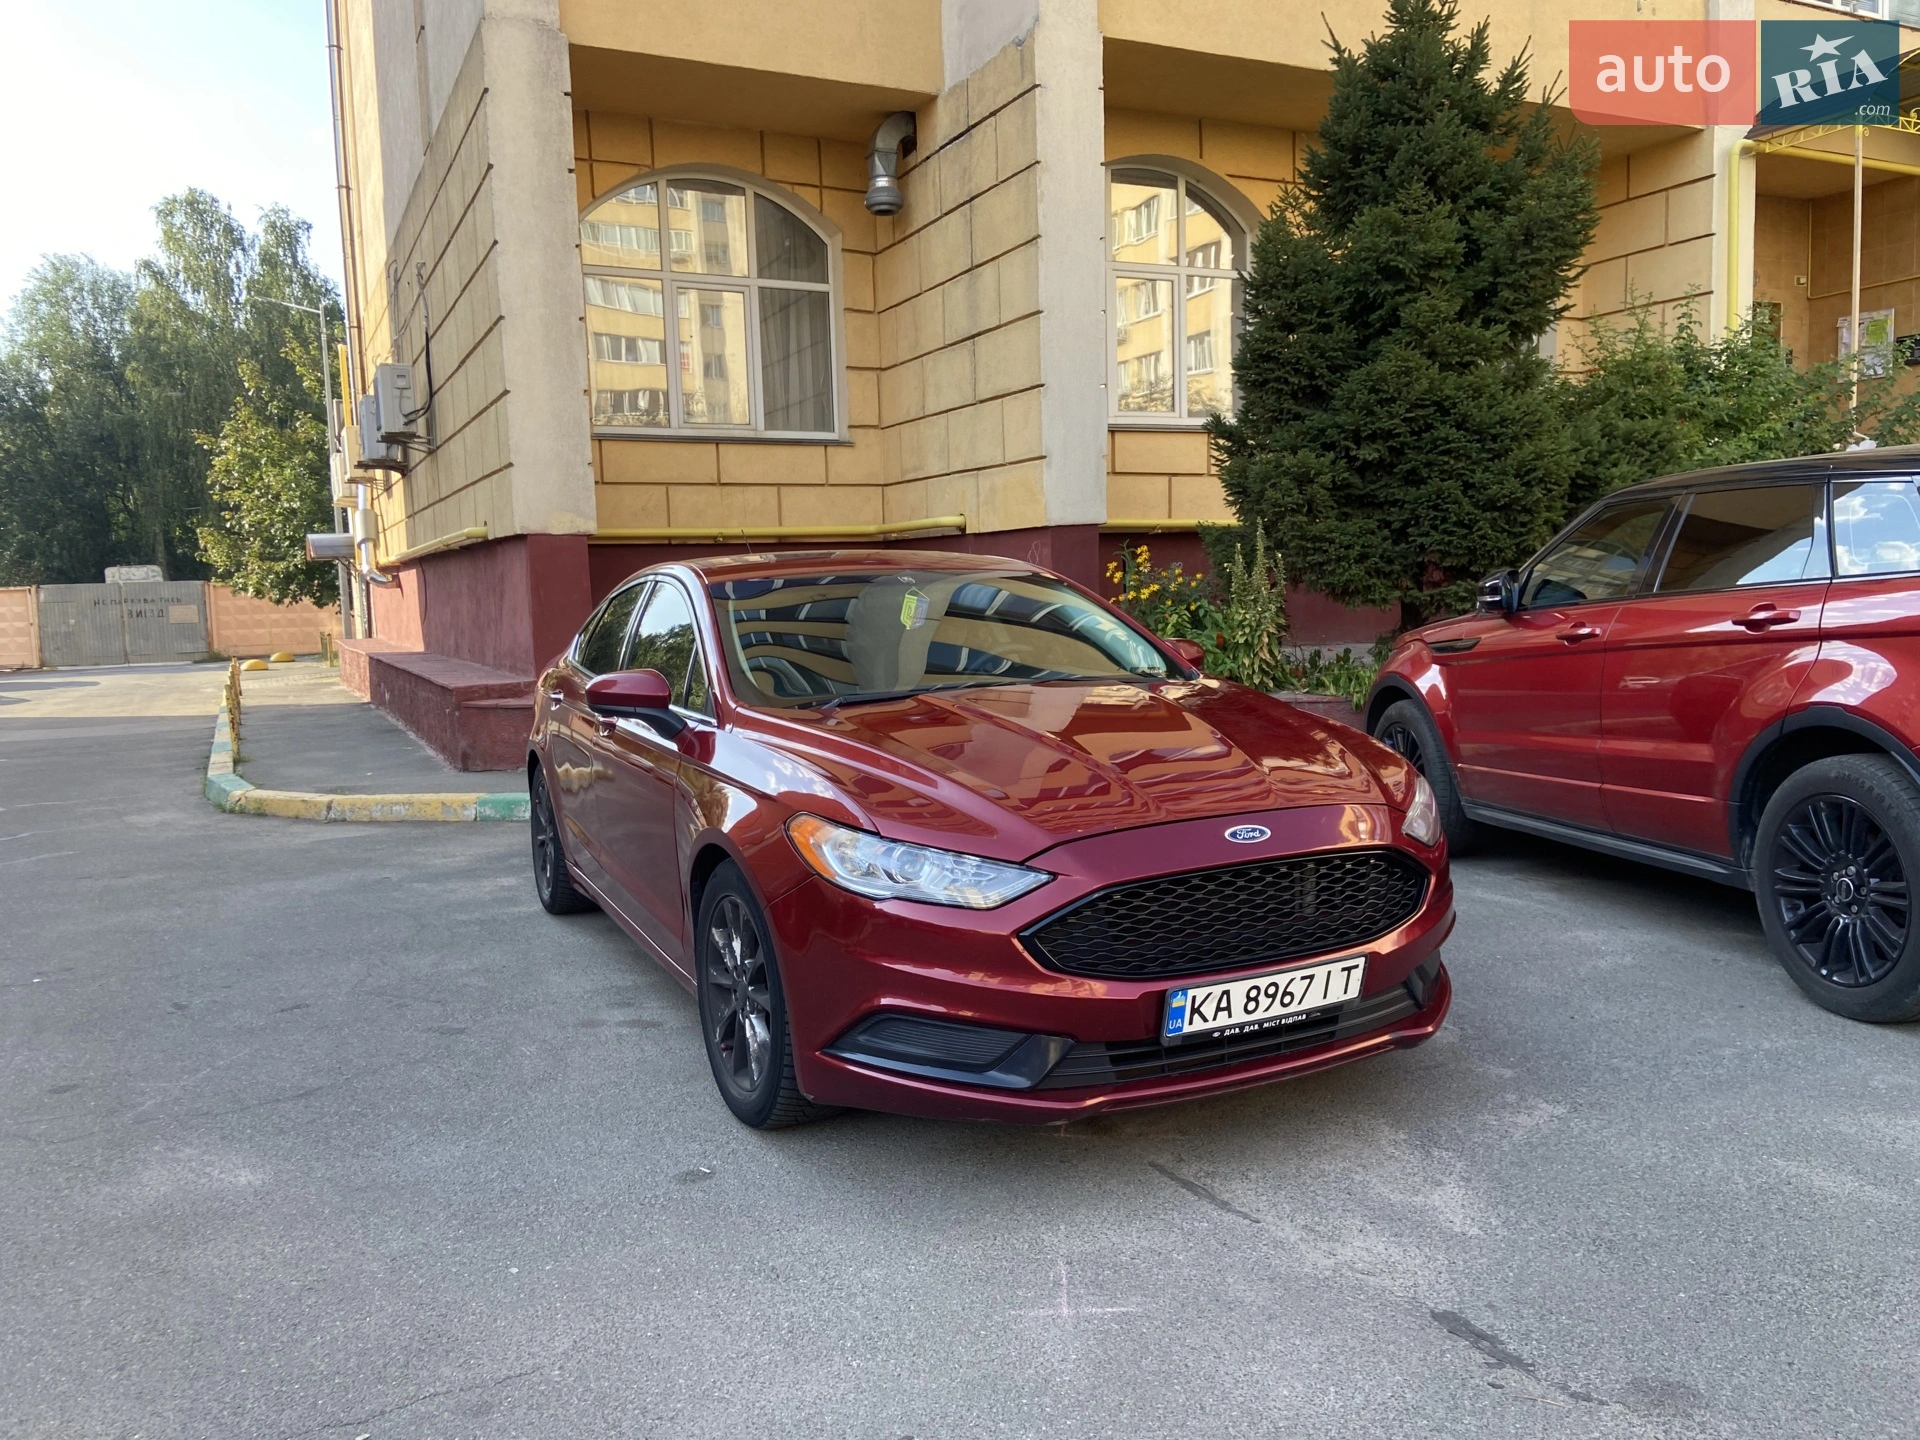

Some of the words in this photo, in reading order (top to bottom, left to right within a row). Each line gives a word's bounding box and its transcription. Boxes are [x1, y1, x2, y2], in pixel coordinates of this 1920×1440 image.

[1236, 828, 1262, 840] Ford
[1188, 989, 1233, 1026] KA
[1243, 973, 1316, 1016] 8967
[1322, 964, 1360, 1000] IT
[1168, 1019, 1183, 1030] UA
